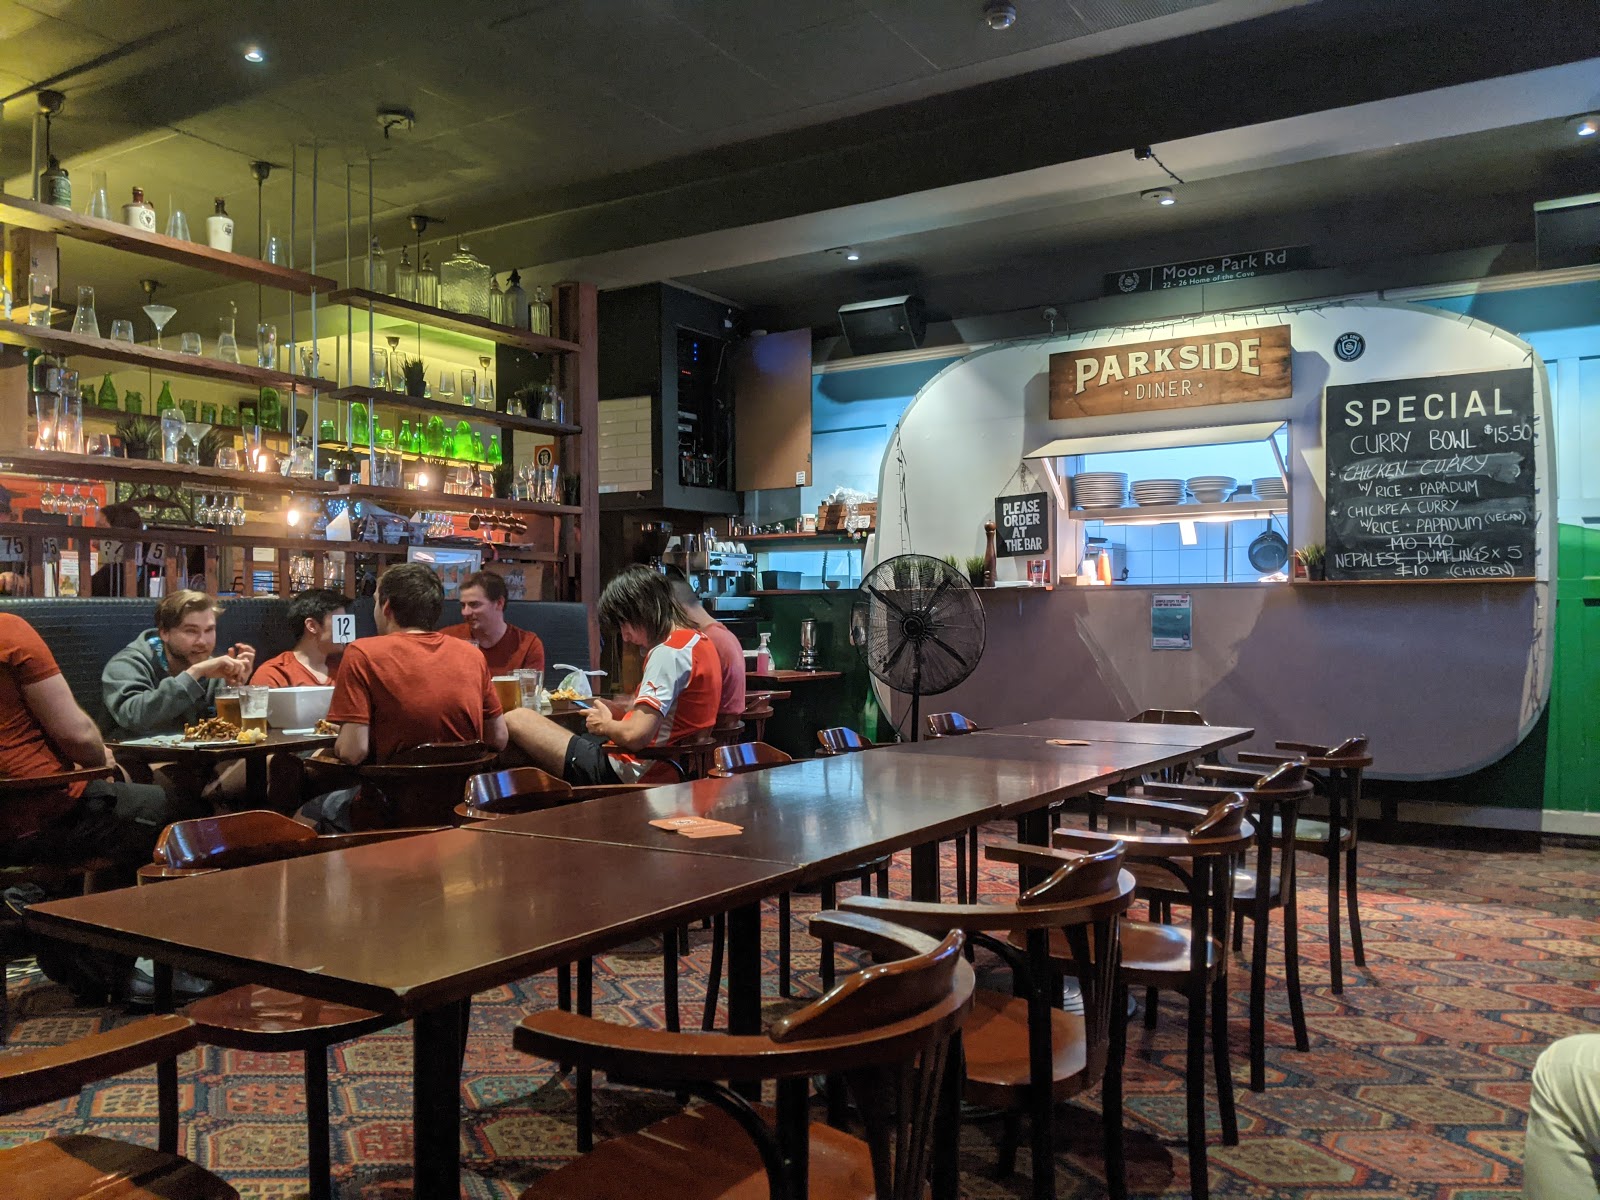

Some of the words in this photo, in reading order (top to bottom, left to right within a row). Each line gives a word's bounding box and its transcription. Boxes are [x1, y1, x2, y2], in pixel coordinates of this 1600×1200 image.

[1162, 264, 1215, 280] Moore
[1221, 255, 1258, 271] Park
[1264, 250, 1287, 265] Rd
[1162, 281, 1171, 289] 22
[1189, 277, 1210, 285] Home
[1074, 337, 1261, 395] PARKSIDE
[1136, 379, 1192, 400] DINER
[1344, 388, 1513, 427] SPECIAL
[1350, 431, 1411, 455] CURRY
[1429, 428, 1477, 450] BOWL
[1343, 460, 1408, 482] CHICKEN
[1420, 453, 1489, 476] CURRY
[1375, 484, 1402, 497] RICE
[1419, 480, 1480, 497] PAPADUM
[1002, 499, 1040, 516] PLEASE
[1417, 499, 1459, 514] CURRY
[1003, 513, 1041, 527] ORDER
[1012, 526, 1027, 539] AT
[1004, 538, 1023, 552] THE
[1024, 536, 1042, 550] BAR
[1335, 551, 1406, 568] NEPALESE
[1417, 546, 1490, 565] DUMPLINGS
[1506, 545, 1523, 560] 5
[337, 617, 351, 636] 12
